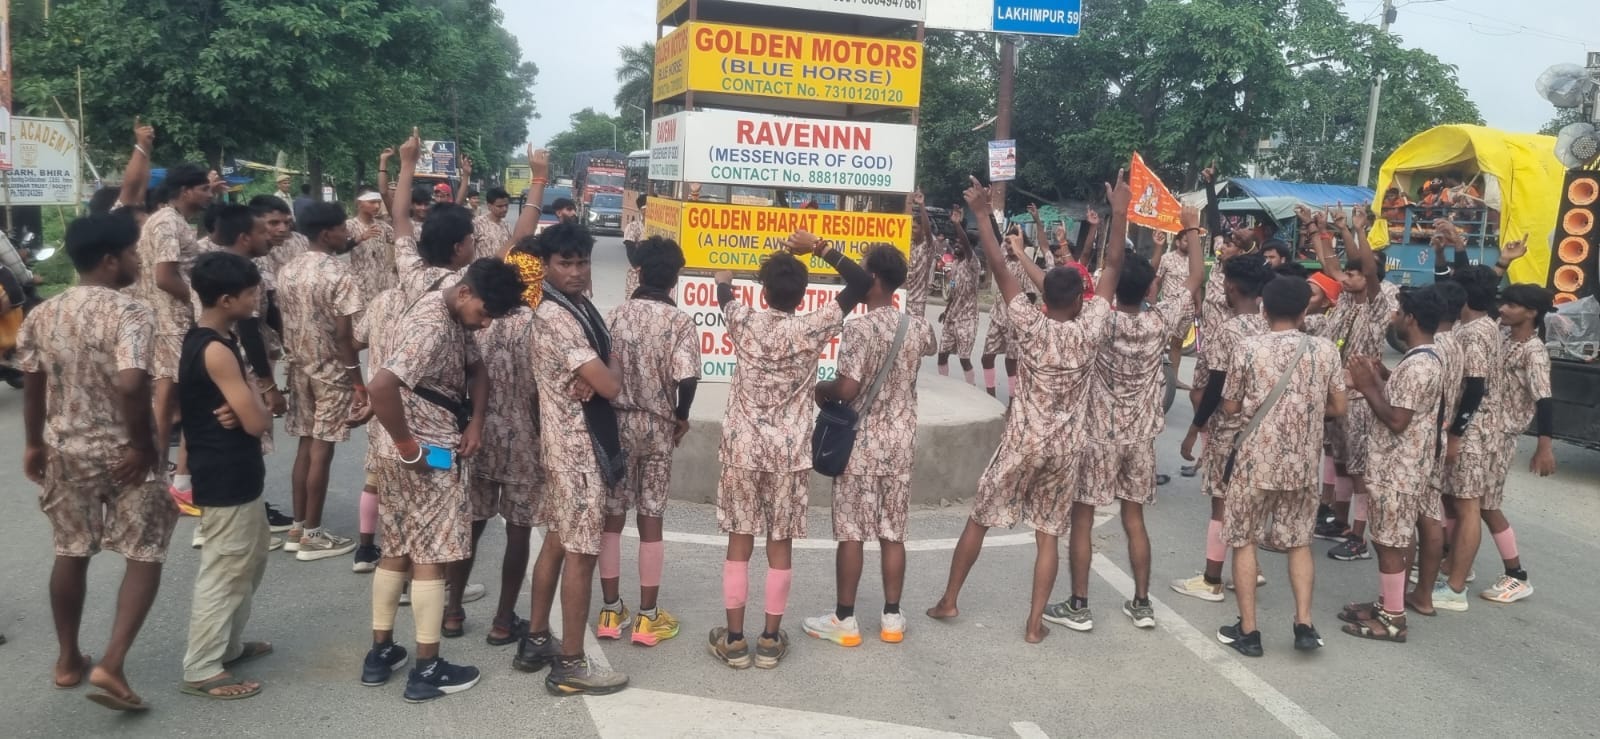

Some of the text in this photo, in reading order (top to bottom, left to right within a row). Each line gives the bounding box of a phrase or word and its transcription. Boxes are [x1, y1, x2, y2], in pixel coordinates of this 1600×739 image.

[997, 6, 1079, 25] LAKHIMPUR 59
[695, 27, 803, 60] GOLDEN
[811, 38, 917, 69] MOTORS
[721, 56, 892, 86] (BLUE HORSE)
[721, 77, 903, 103] CONTACT No. 7310120120
[20, 121, 74, 157] ACADEMY
[736, 119, 871, 151] RAVENNN
[709, 145, 893, 171] (MESSENGER OF GOD)
[39, 169, 71, 177] BHIRA
[711, 165, 892, 187] CONTACT No. 88818700999
[688, 207, 751, 231] GOLDEN
[756, 210, 818, 233] BHARAT
[822, 214, 906, 239] RESIDENCY
[698, 231, 714, 249] (A
[718, 233, 760, 249] HOME
[763, 236, 788, 250] AW
[684, 282, 754, 309] GOLEN
